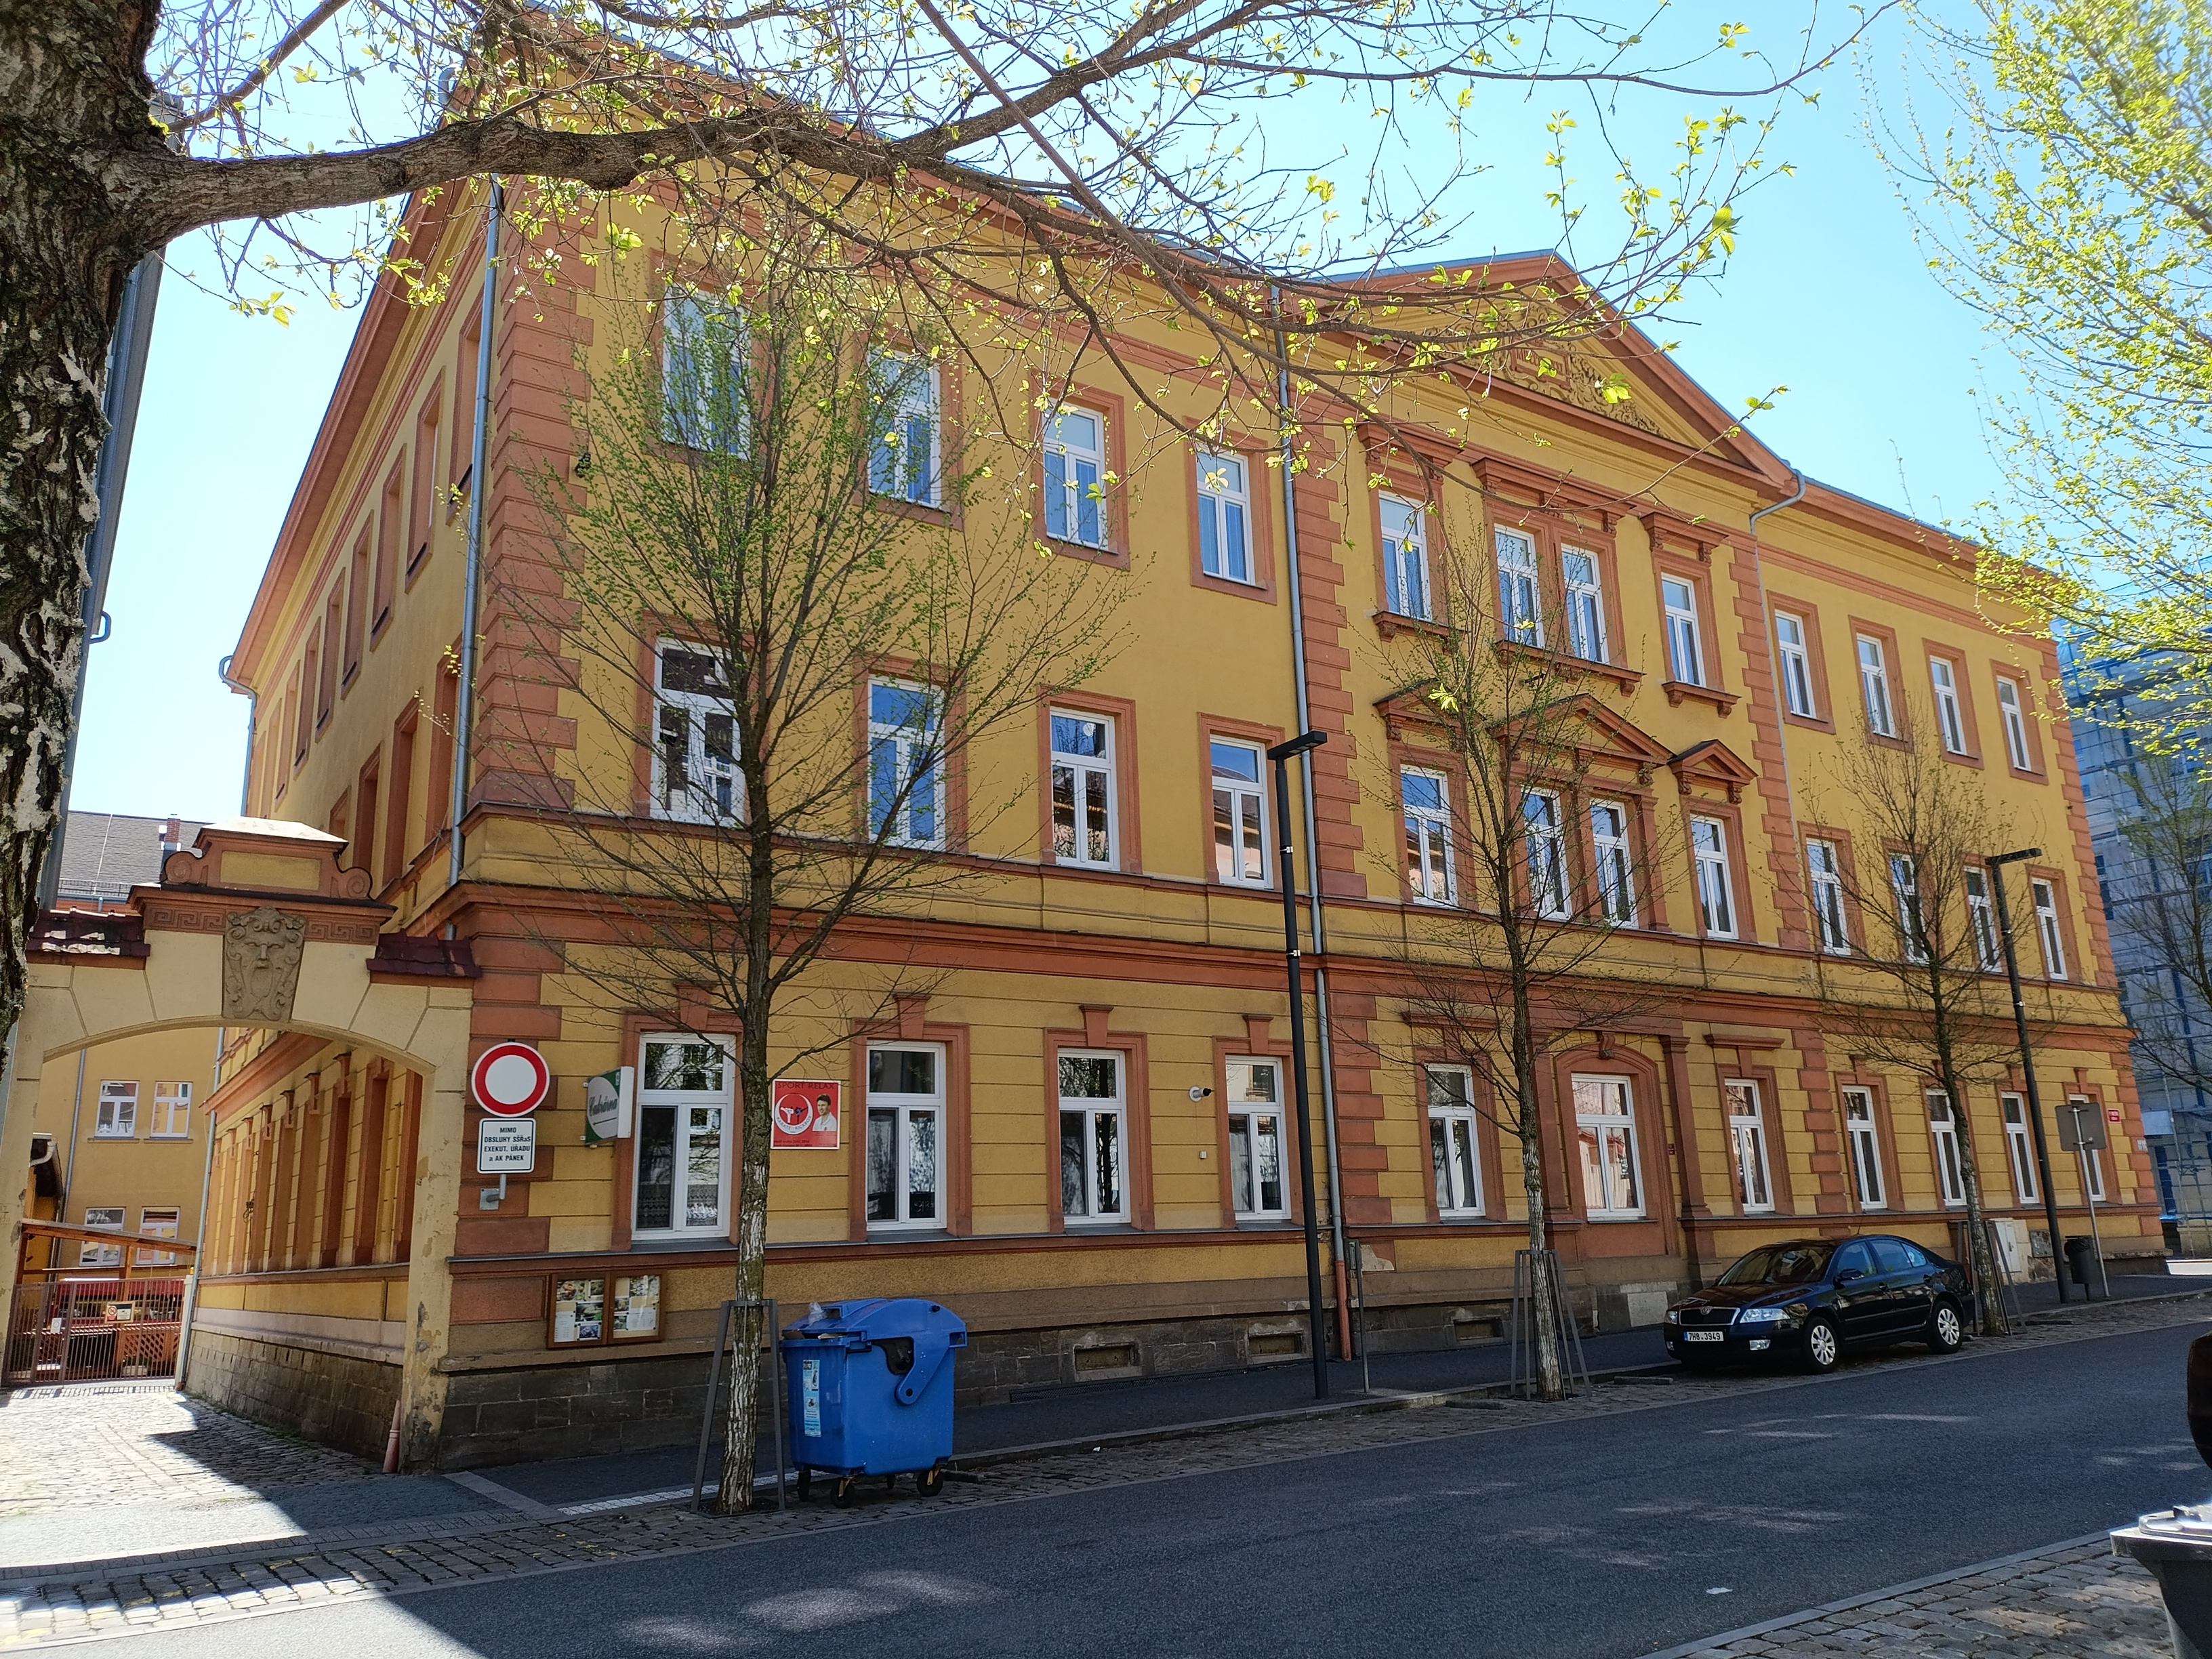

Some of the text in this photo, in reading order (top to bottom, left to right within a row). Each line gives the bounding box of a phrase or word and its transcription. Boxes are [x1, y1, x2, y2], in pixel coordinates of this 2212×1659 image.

[776, 1115, 811, 1130] KARATE KICKBOX
[510, 1144, 531, 1152] ÚŘADU
